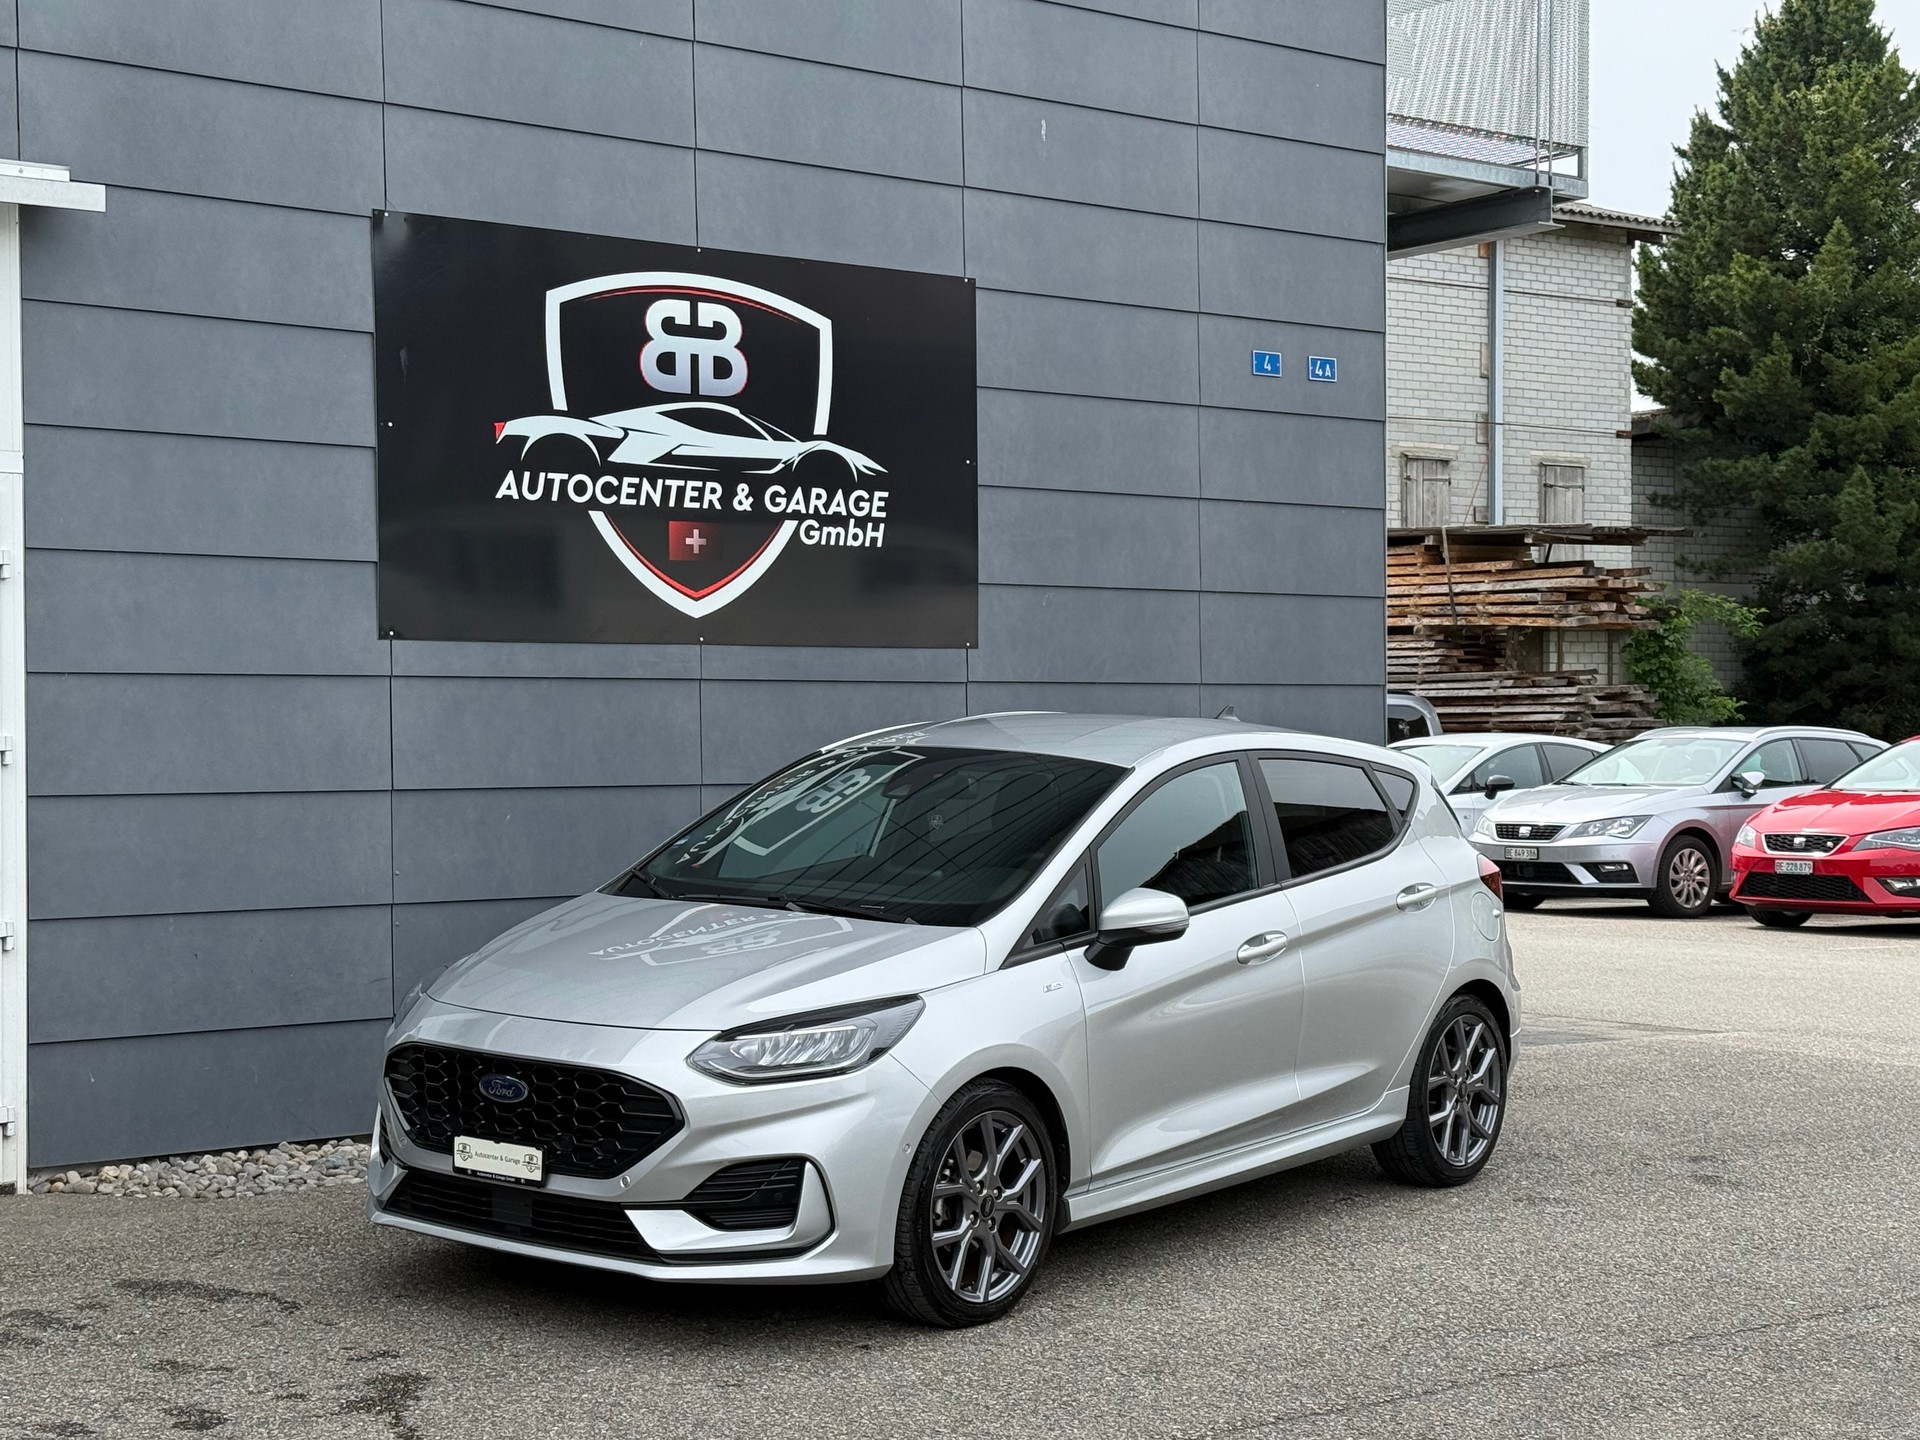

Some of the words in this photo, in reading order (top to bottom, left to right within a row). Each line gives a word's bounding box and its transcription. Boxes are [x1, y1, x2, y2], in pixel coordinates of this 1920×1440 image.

[1264, 355, 1271, 371] 4
[1315, 360, 1331, 377] 4A
[495, 469, 723, 510] AUTOCENTER
[732, 482, 754, 512] &
[764, 484, 890, 518] GARAGE
[799, 518, 885, 548] GmbH
[1506, 848, 1513, 857] BE
[1776, 861, 1784, 871] BE
[488, 1080, 516, 1098] Ford
[474, 1150, 499, 1161] Autocenter
[504, 1156, 521, 1165] Garage
